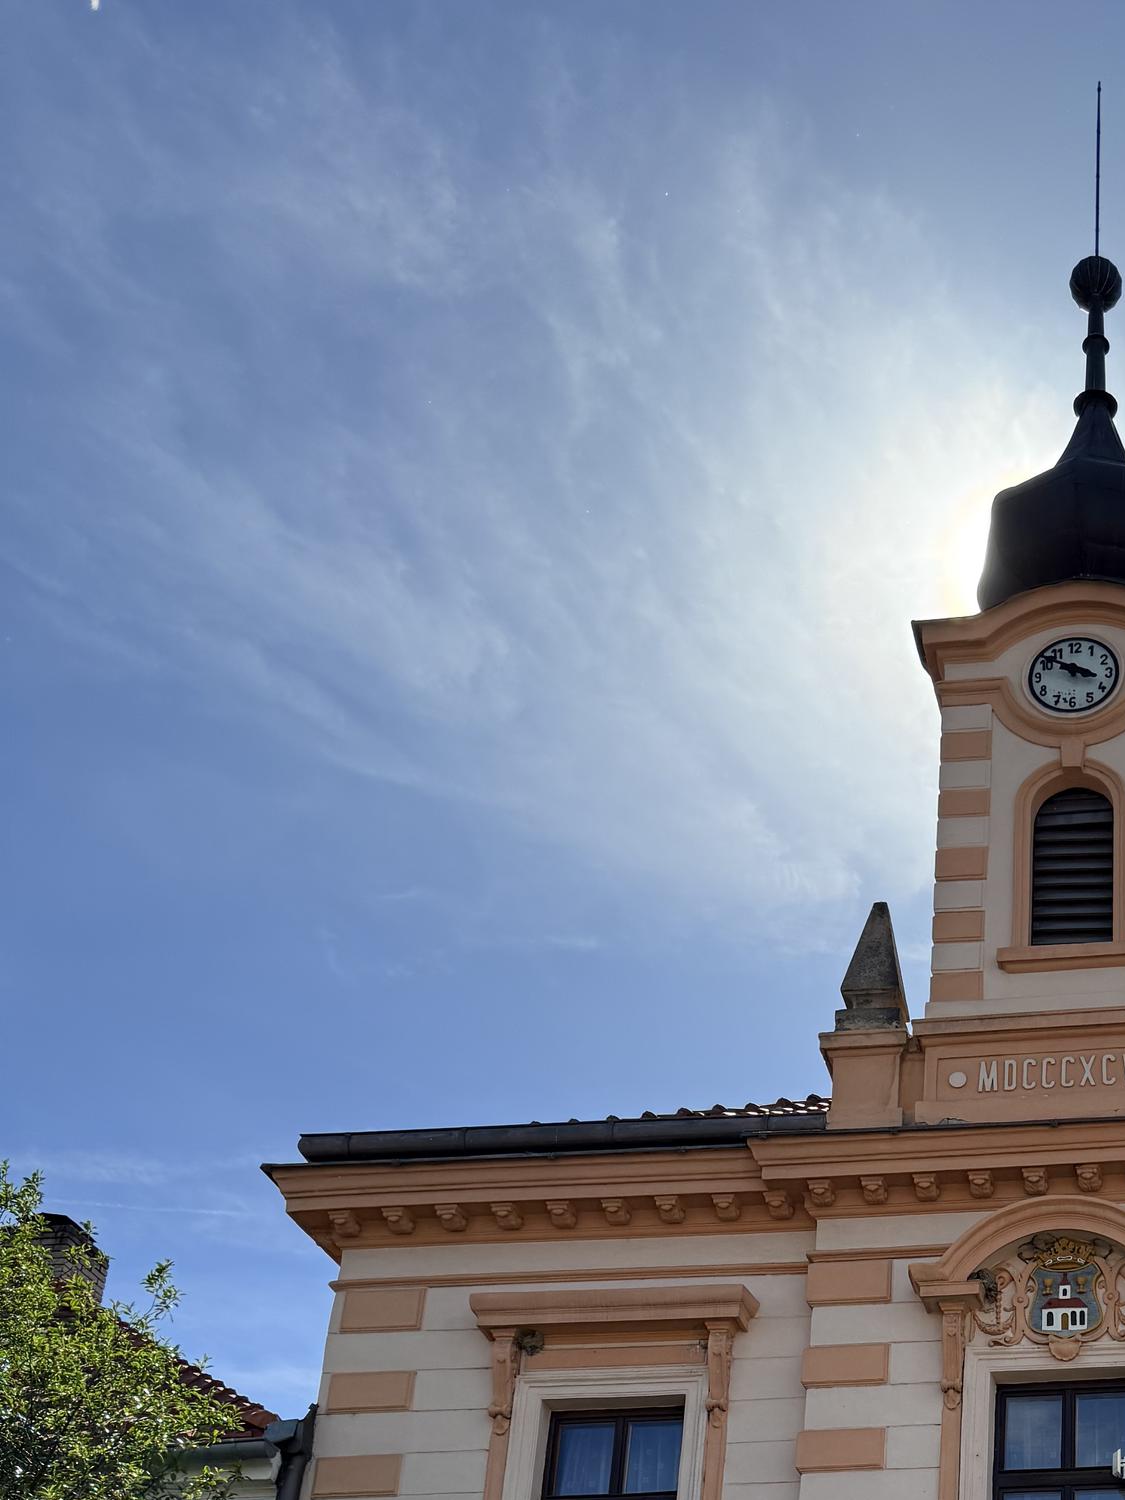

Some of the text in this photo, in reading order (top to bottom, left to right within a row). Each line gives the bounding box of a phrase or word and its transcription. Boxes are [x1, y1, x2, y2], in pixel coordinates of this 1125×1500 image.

[1068, 642, 1082, 654] 12
[1088, 645, 1094, 657] 1
[1100, 654, 1108, 665] 2
[1040, 660, 1053, 671] 10
[1034, 672, 1042, 683] 9
[1105, 667, 1113, 678] 3
[1040, 685, 1047, 696] 8
[1098, 682, 1107, 693] 4
[1053, 695, 1061, 706] 7
[1069, 696, 1076, 708] 6
[1086, 692, 1094, 703] 5
